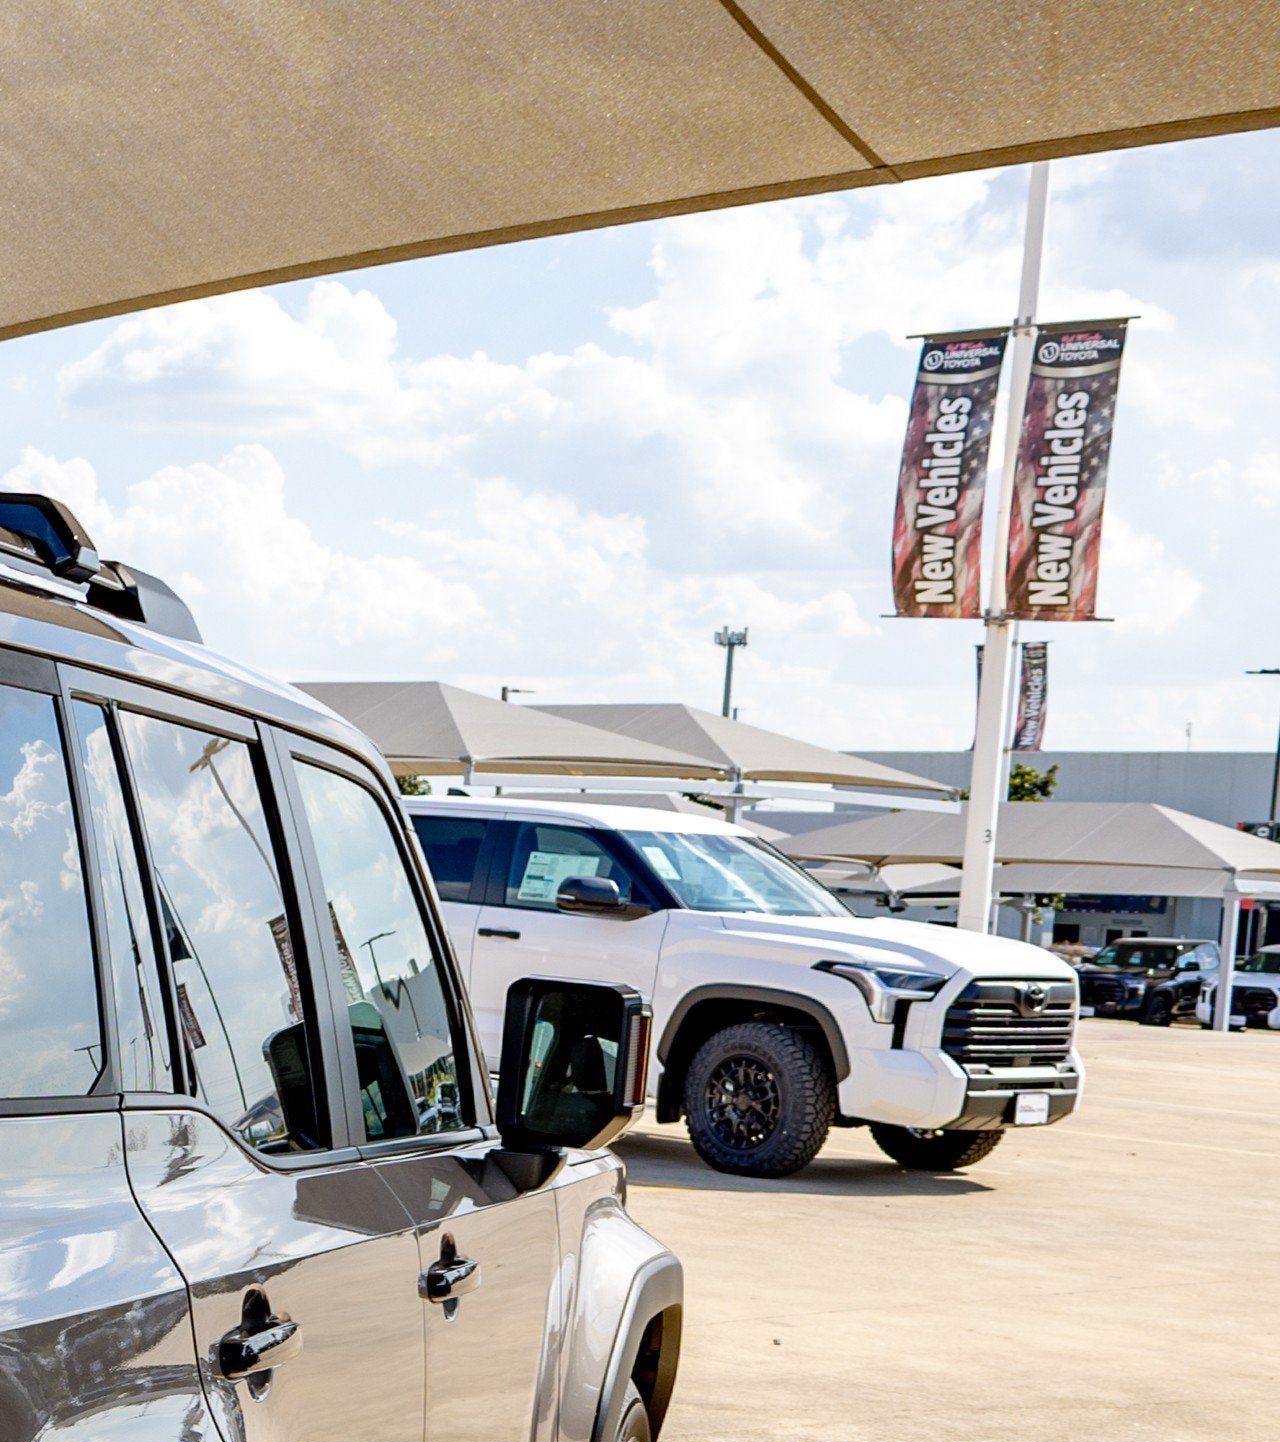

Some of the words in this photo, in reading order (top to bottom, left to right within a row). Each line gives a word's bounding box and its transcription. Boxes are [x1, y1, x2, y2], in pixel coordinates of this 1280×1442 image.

[1059, 338, 1121, 352] UNIVERSAL
[1059, 350, 1099, 362] TOYOTA
[916, 396, 973, 530] Vehicles
[1032, 390, 1090, 529] Vehicles
[915, 534, 956, 605] New
[1027, 533, 1074, 606] New
